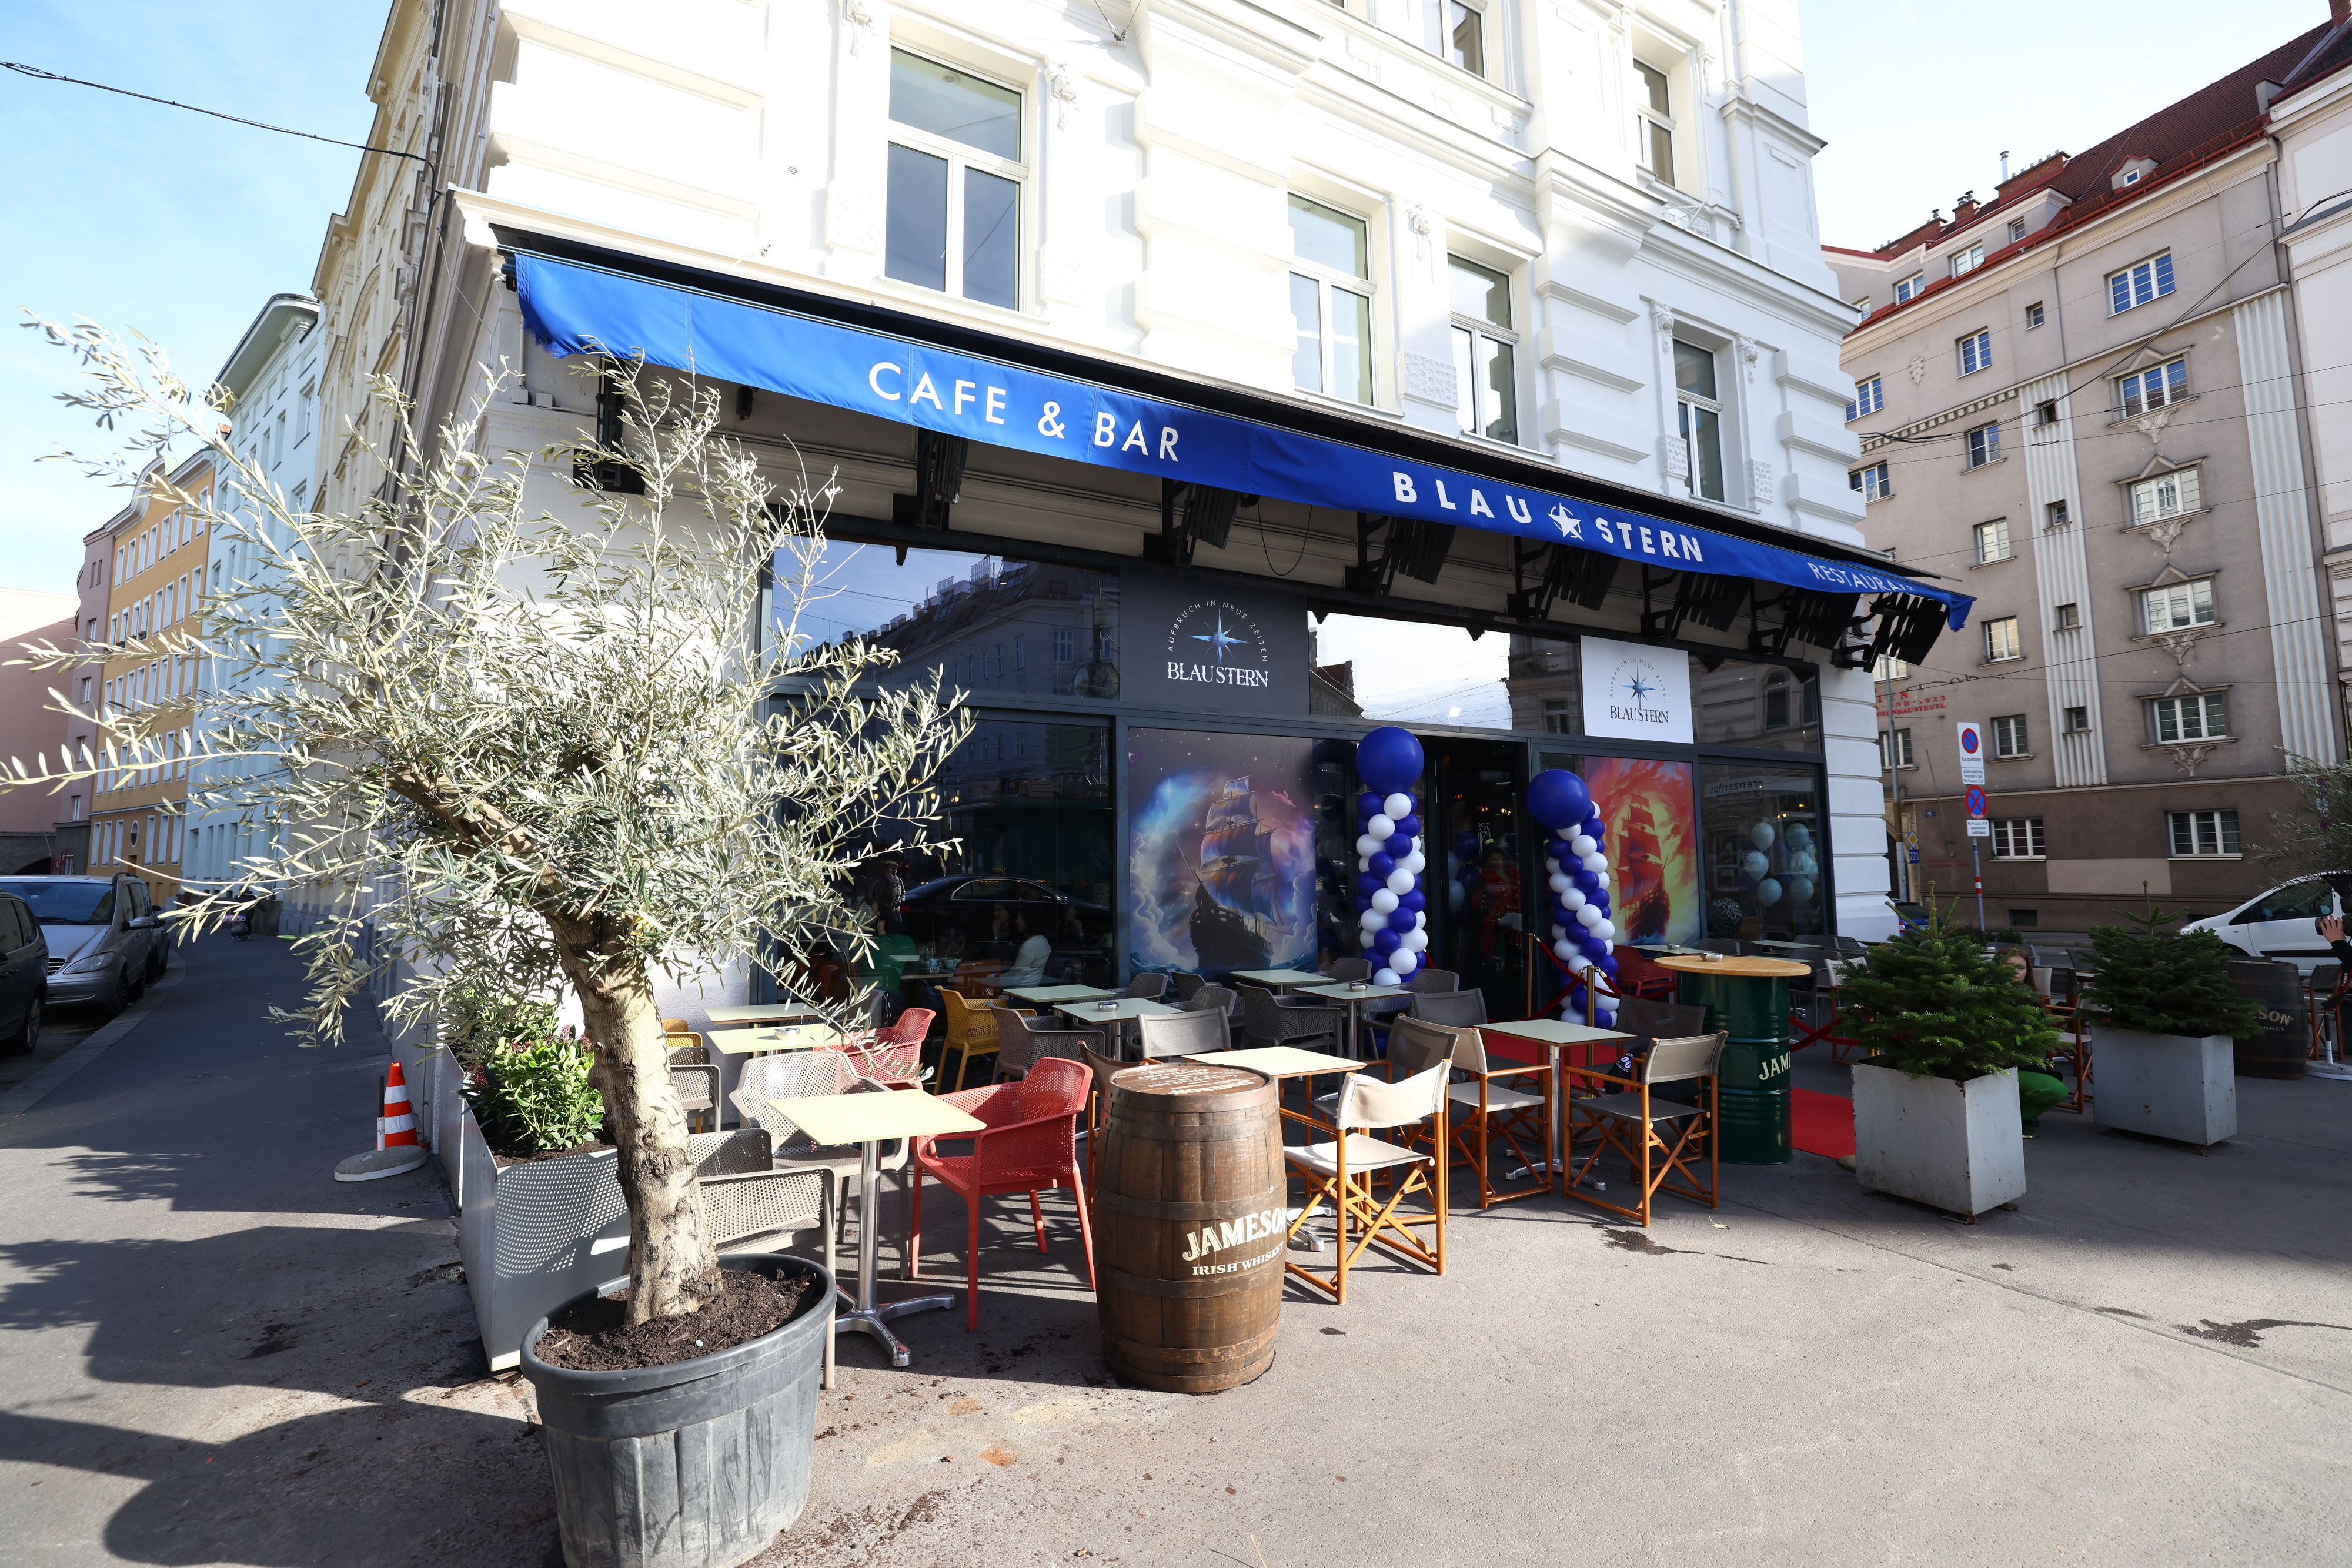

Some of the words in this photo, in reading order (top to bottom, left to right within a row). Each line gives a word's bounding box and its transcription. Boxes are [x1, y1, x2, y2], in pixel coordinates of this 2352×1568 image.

[868, 362, 1007, 425] CAFE
[1038, 401, 1065, 439] &
[1094, 412, 1179, 462] BAR
[1392, 471, 1532, 524] BLAU
[1595, 517, 1703, 562] STERN
[1167, 602, 1201, 652] AUFBRUCH
[1222, 601, 1248, 620] NEUE
[1250, 623, 1268, 662] ZEITEN
[1167, 661, 1268, 687] BLAUSTERN
[1609, 660, 1628, 698] AUFBRUCH
[1639, 658, 1655, 672] NEUE
[1655, 674, 1668, 704] ZEITEN
[1610, 706, 1669, 724] BLAUSTERN
[1192, 1262, 1238, 1276] IRISH
[1242, 1241, 1284, 1271] WHISKEY
